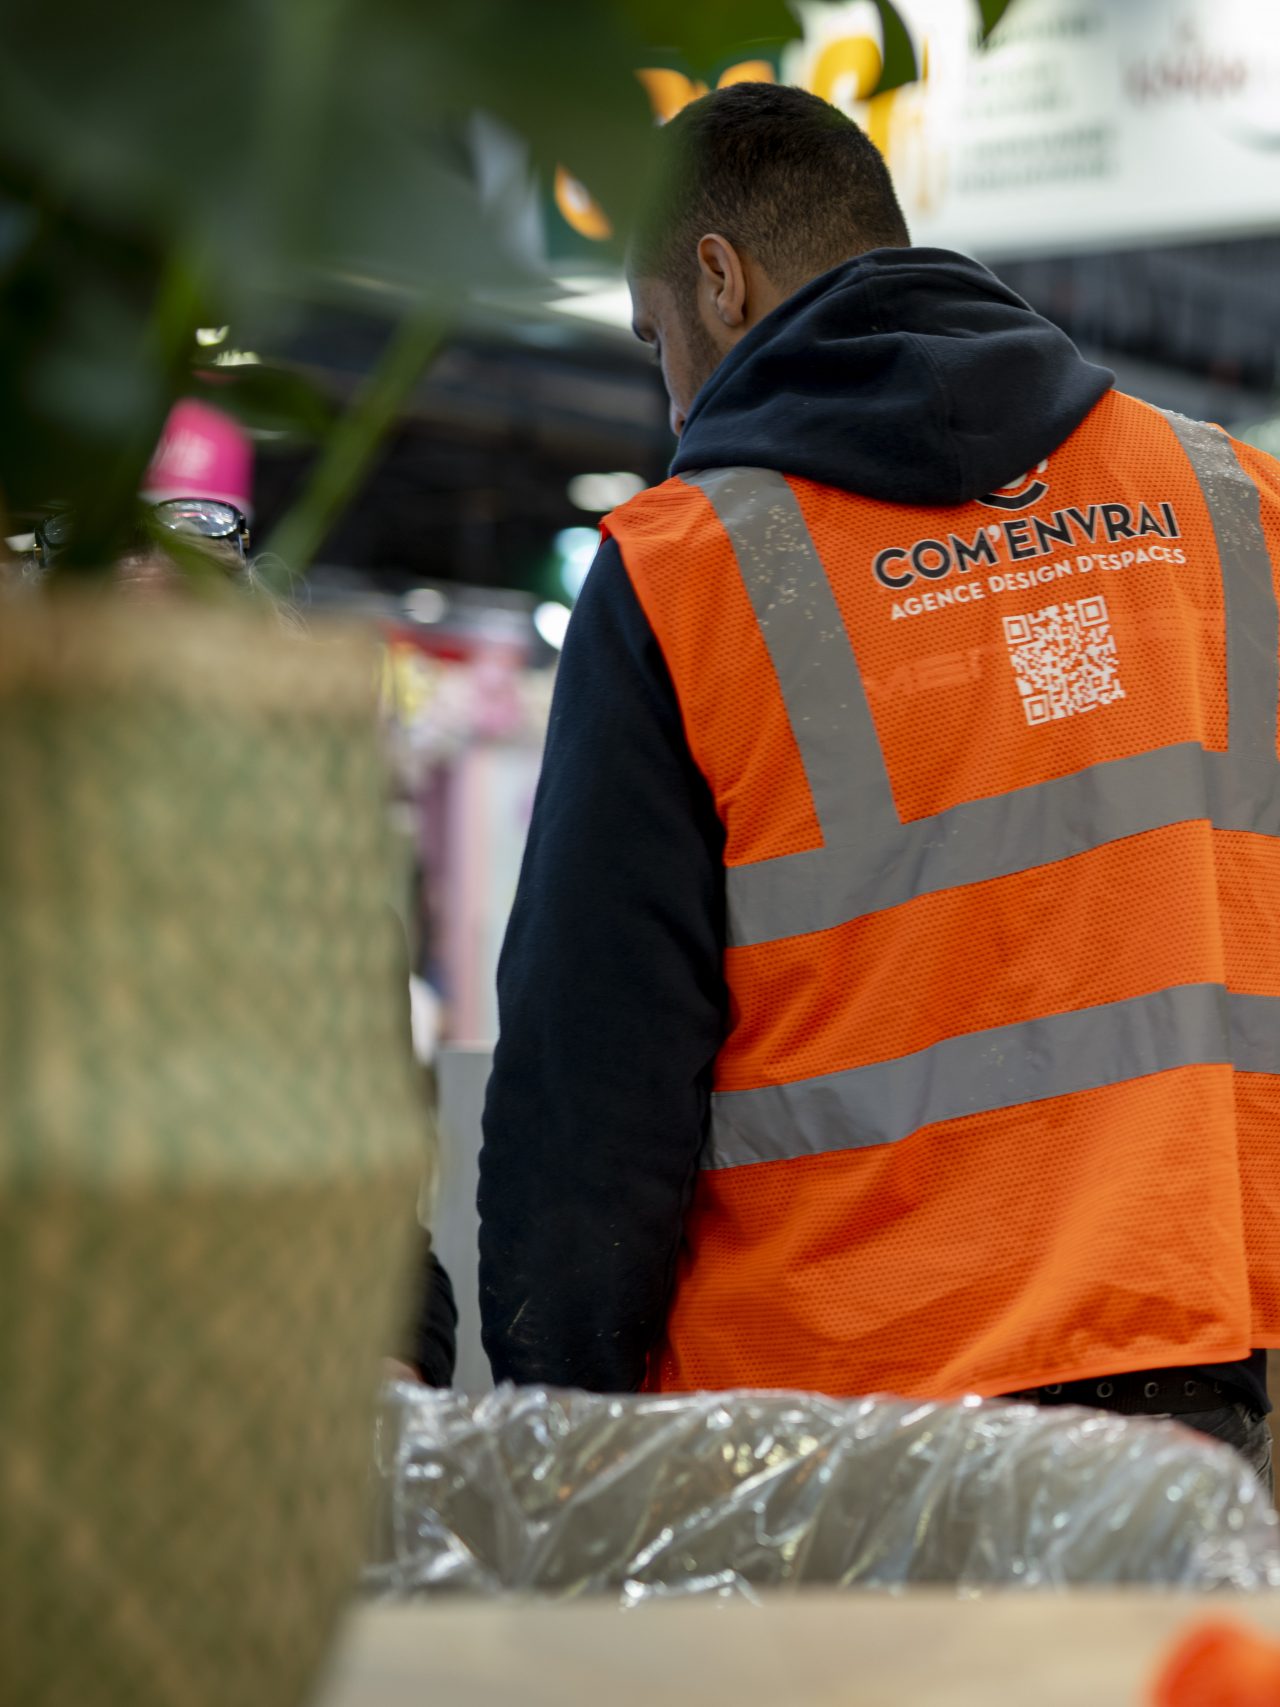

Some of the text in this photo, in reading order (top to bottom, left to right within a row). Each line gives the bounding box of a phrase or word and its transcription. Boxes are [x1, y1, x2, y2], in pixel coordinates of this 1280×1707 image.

[890, 546, 1186, 620] AGENCE DESIGN D'ESPACES
